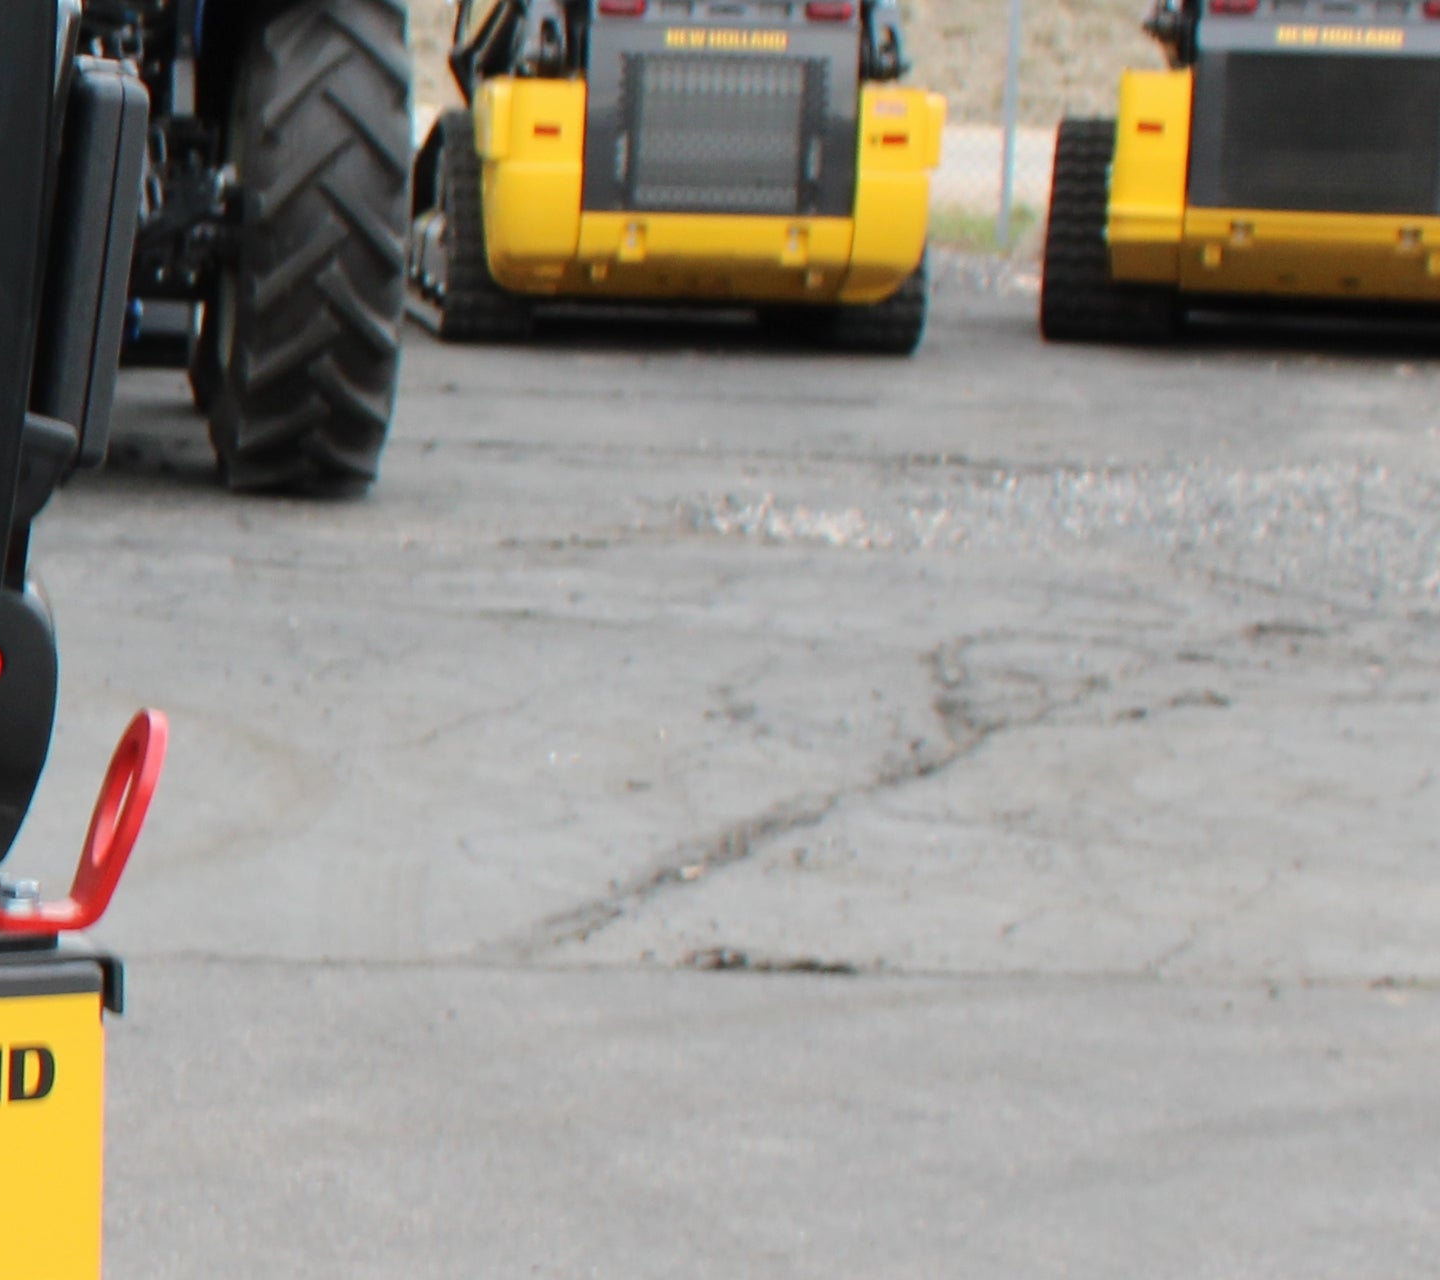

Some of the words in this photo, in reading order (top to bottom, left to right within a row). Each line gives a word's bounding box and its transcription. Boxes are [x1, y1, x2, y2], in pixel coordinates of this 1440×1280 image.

[667, 28, 706, 50] NEW
[708, 28, 789, 52] HOLLAND
[1277, 24, 1319, 47] NEW
[1321, 26, 1404, 50] HOLLAND
